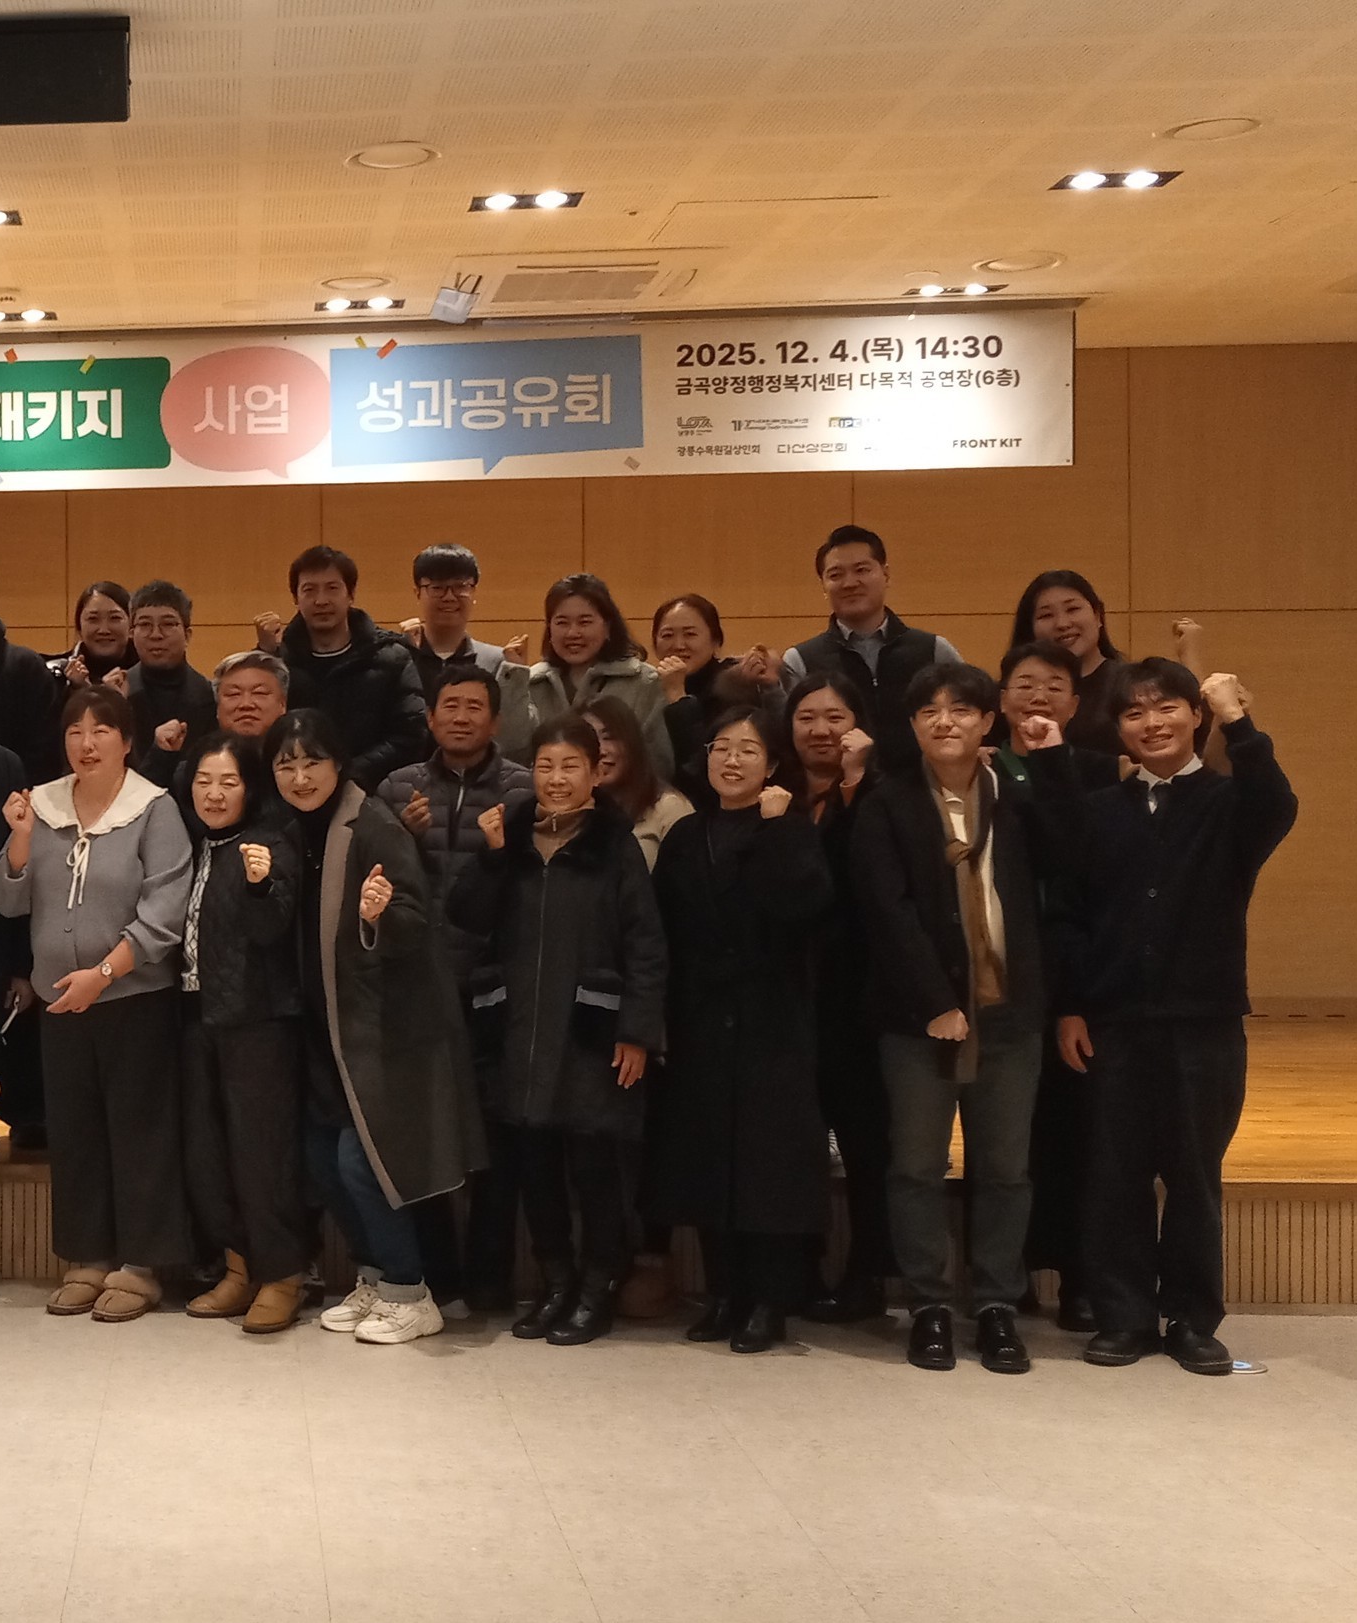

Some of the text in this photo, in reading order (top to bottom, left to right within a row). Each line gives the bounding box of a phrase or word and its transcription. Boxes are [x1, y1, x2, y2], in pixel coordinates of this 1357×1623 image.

[676, 335, 1003, 367] 2025. 12. 4.(목) 14:30
[675, 368, 1021, 395] 금곡양정행정복지센터 다목적 공연장(6층)
[193, 383, 290, 435] 사업
[356, 373, 612, 433] 성과공유회
[777, 442, 848, 454] 다산상인회
[952, 438, 1022, 449] FRONT KIT
